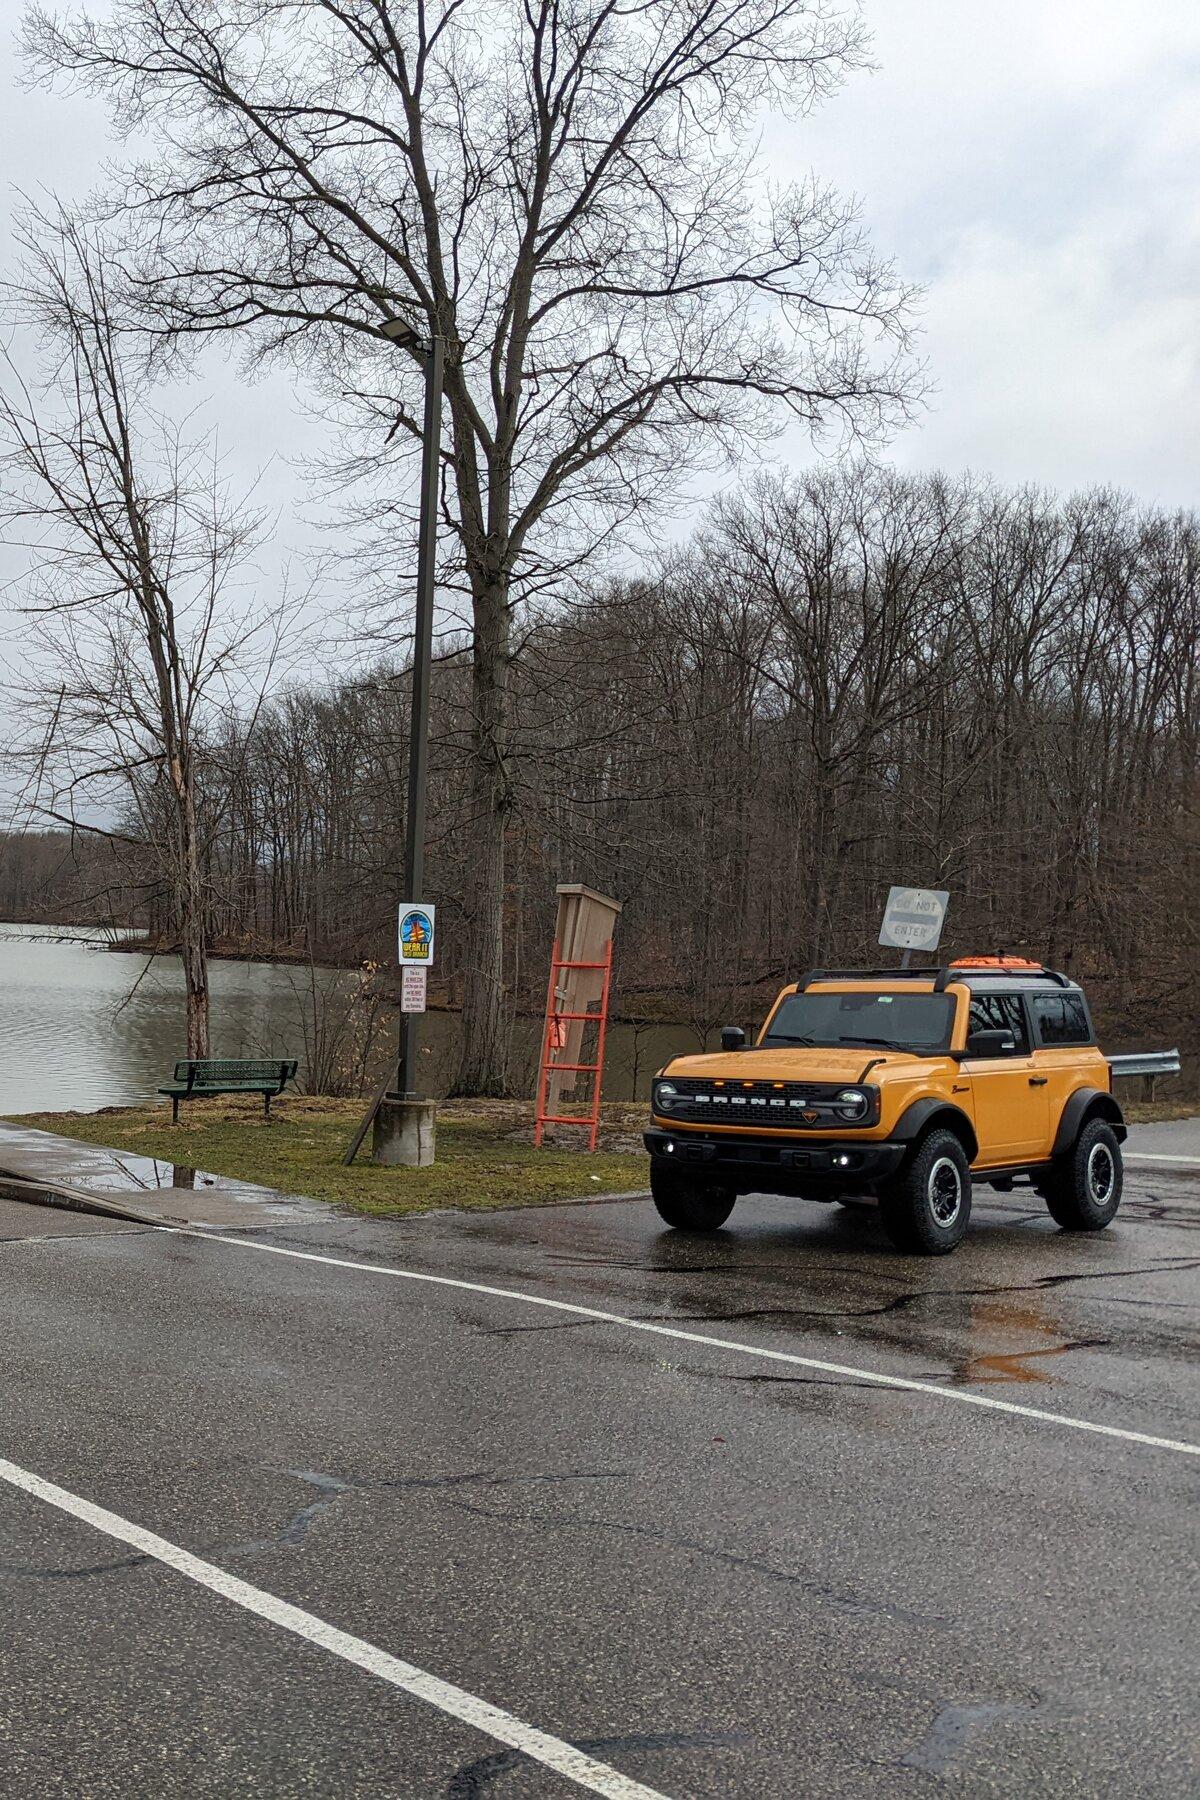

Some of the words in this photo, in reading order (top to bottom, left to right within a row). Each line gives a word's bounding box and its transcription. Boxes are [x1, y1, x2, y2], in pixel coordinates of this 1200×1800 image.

[916, 901, 937, 911] NOT
[894, 925, 926, 937] ENTER
[403, 943, 421, 951] WEAR
[422, 943, 428, 951] IT
[695, 1096, 806, 1107] BRONCO
